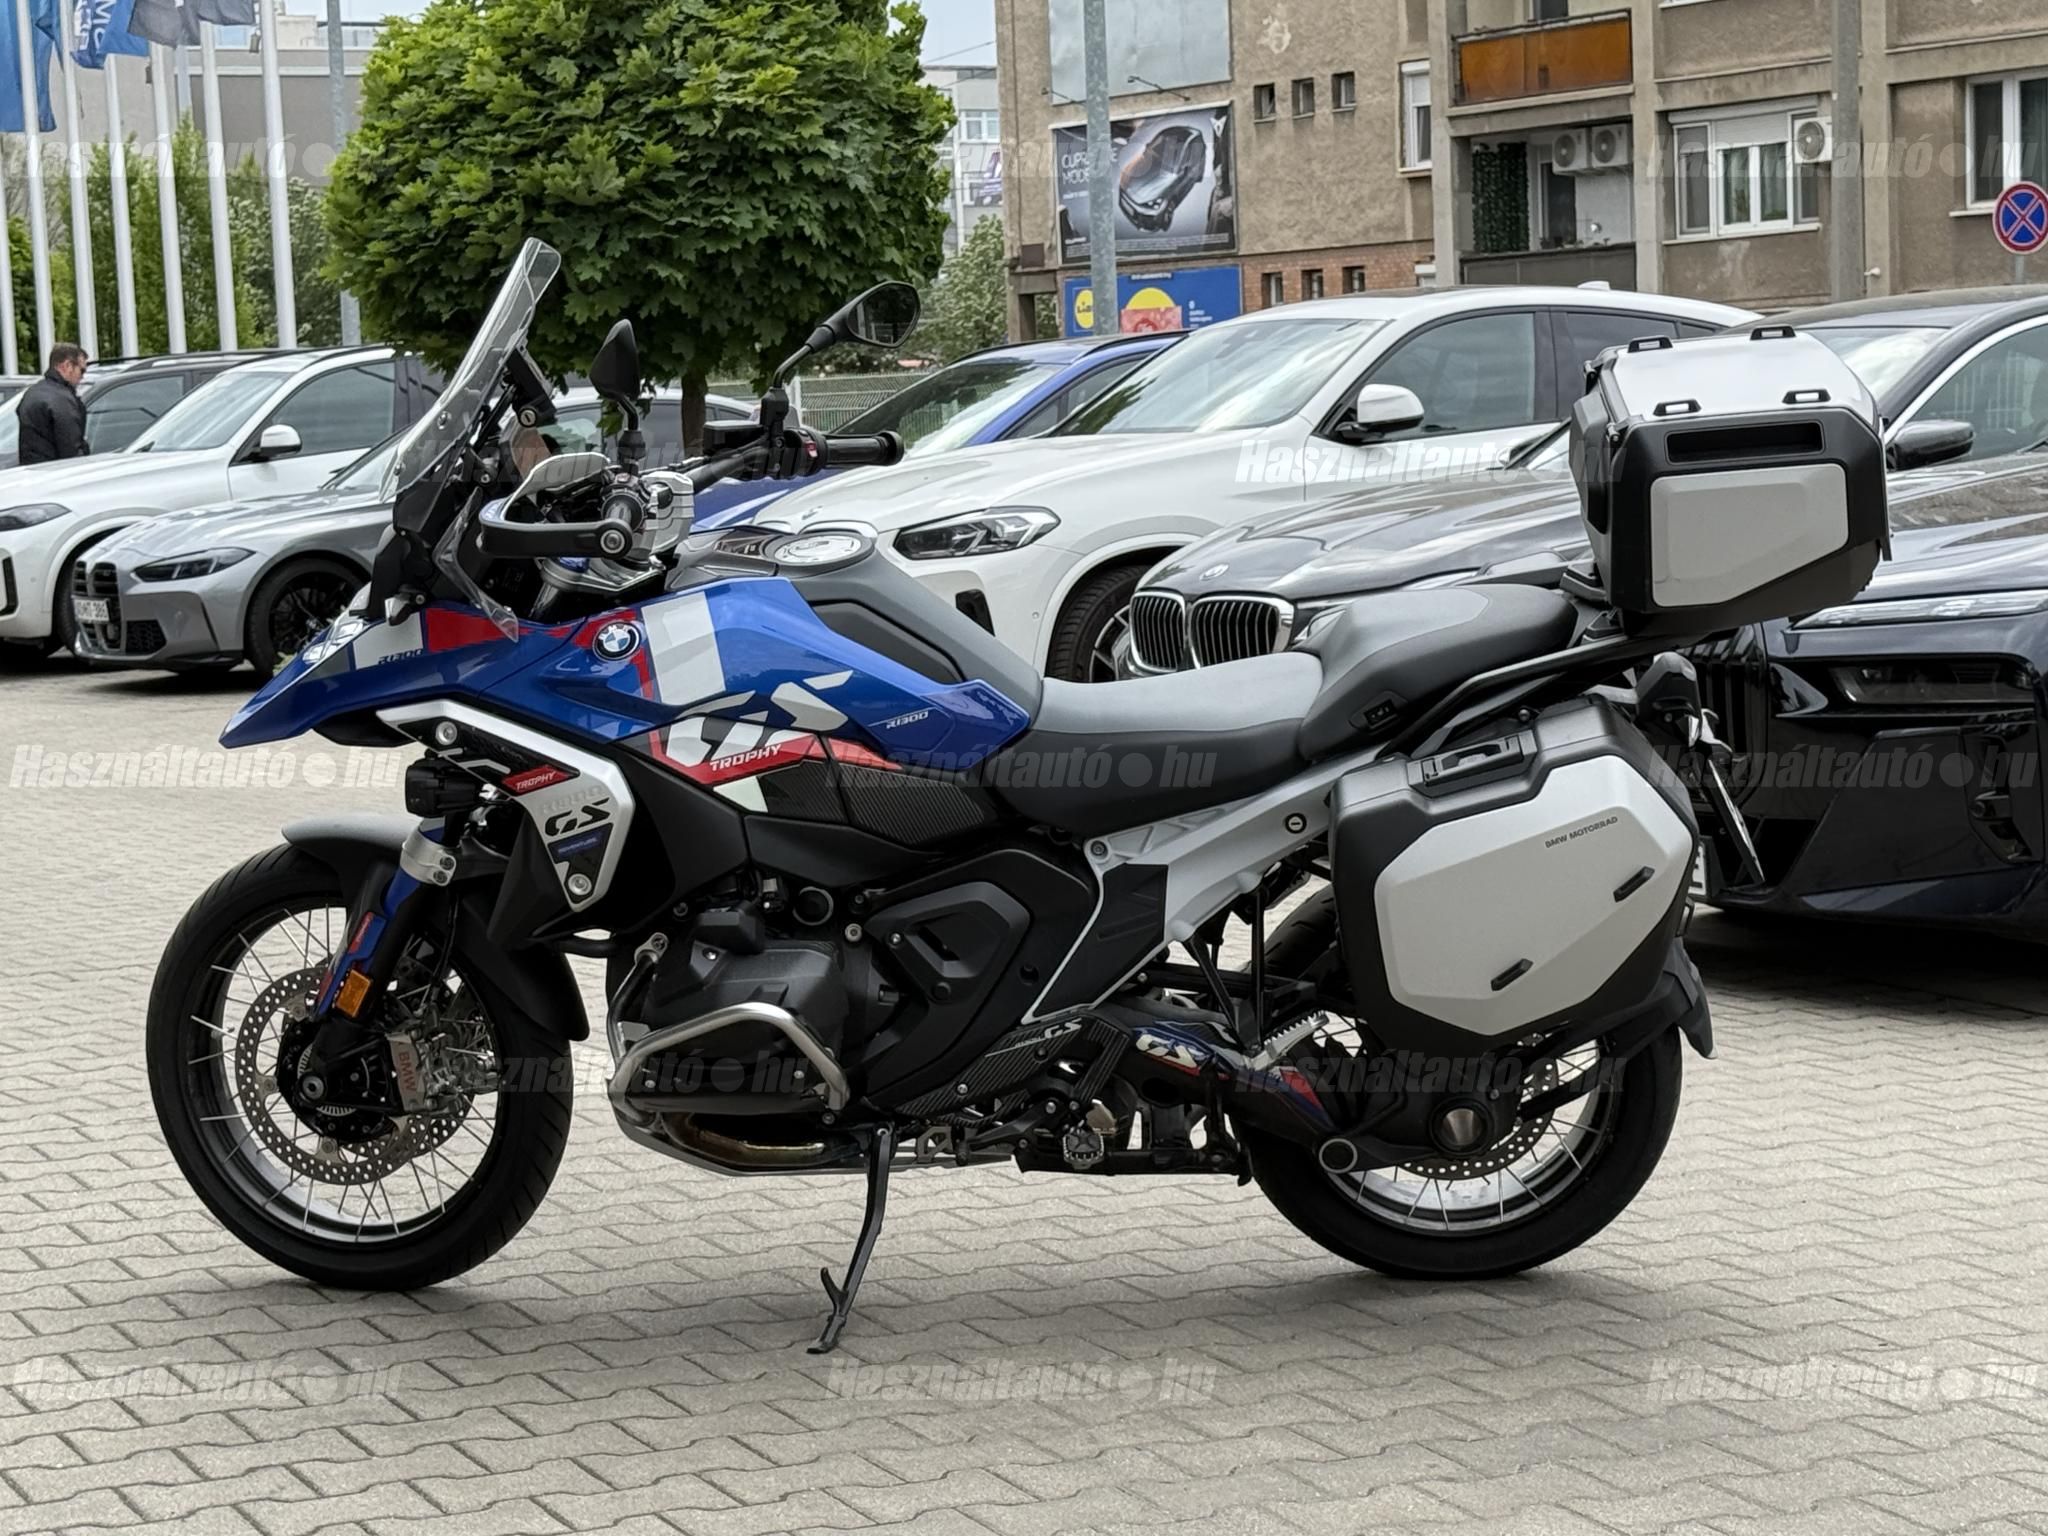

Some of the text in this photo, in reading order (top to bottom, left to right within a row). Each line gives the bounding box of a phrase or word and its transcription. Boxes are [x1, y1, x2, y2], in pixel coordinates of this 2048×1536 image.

[709, 744, 782, 772] TROPHY
[515, 770, 557, 791] TROPHY
[1545, 816, 1618, 848] BMW MOTORRAD
[399, 1051, 418, 1091] BMW
